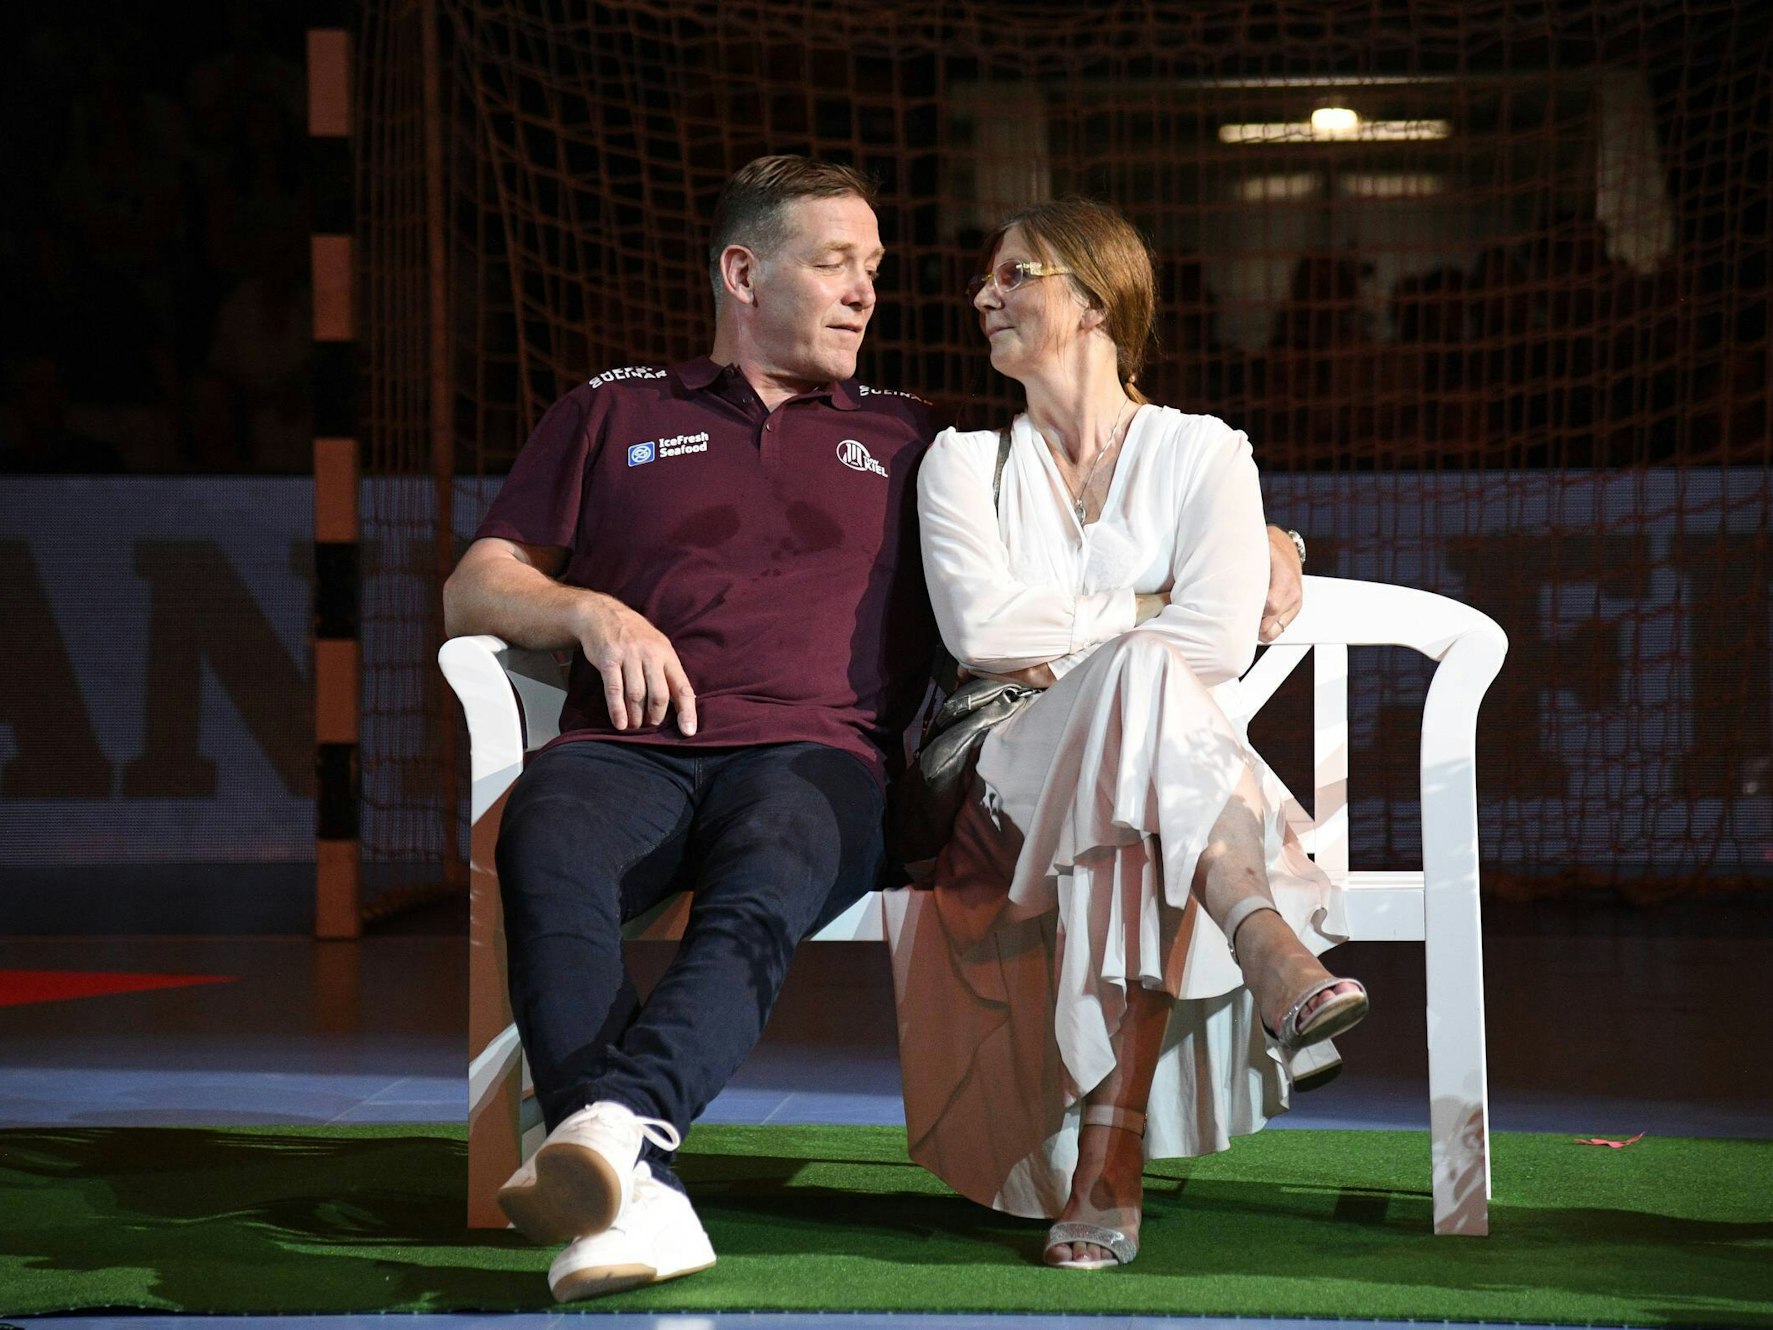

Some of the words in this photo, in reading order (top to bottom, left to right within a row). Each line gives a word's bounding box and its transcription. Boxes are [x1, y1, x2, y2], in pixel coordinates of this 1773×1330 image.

[659, 431, 710, 448] IceFresh
[659, 441, 708, 458] Seafood
[864, 461, 888, 478] KIEL
